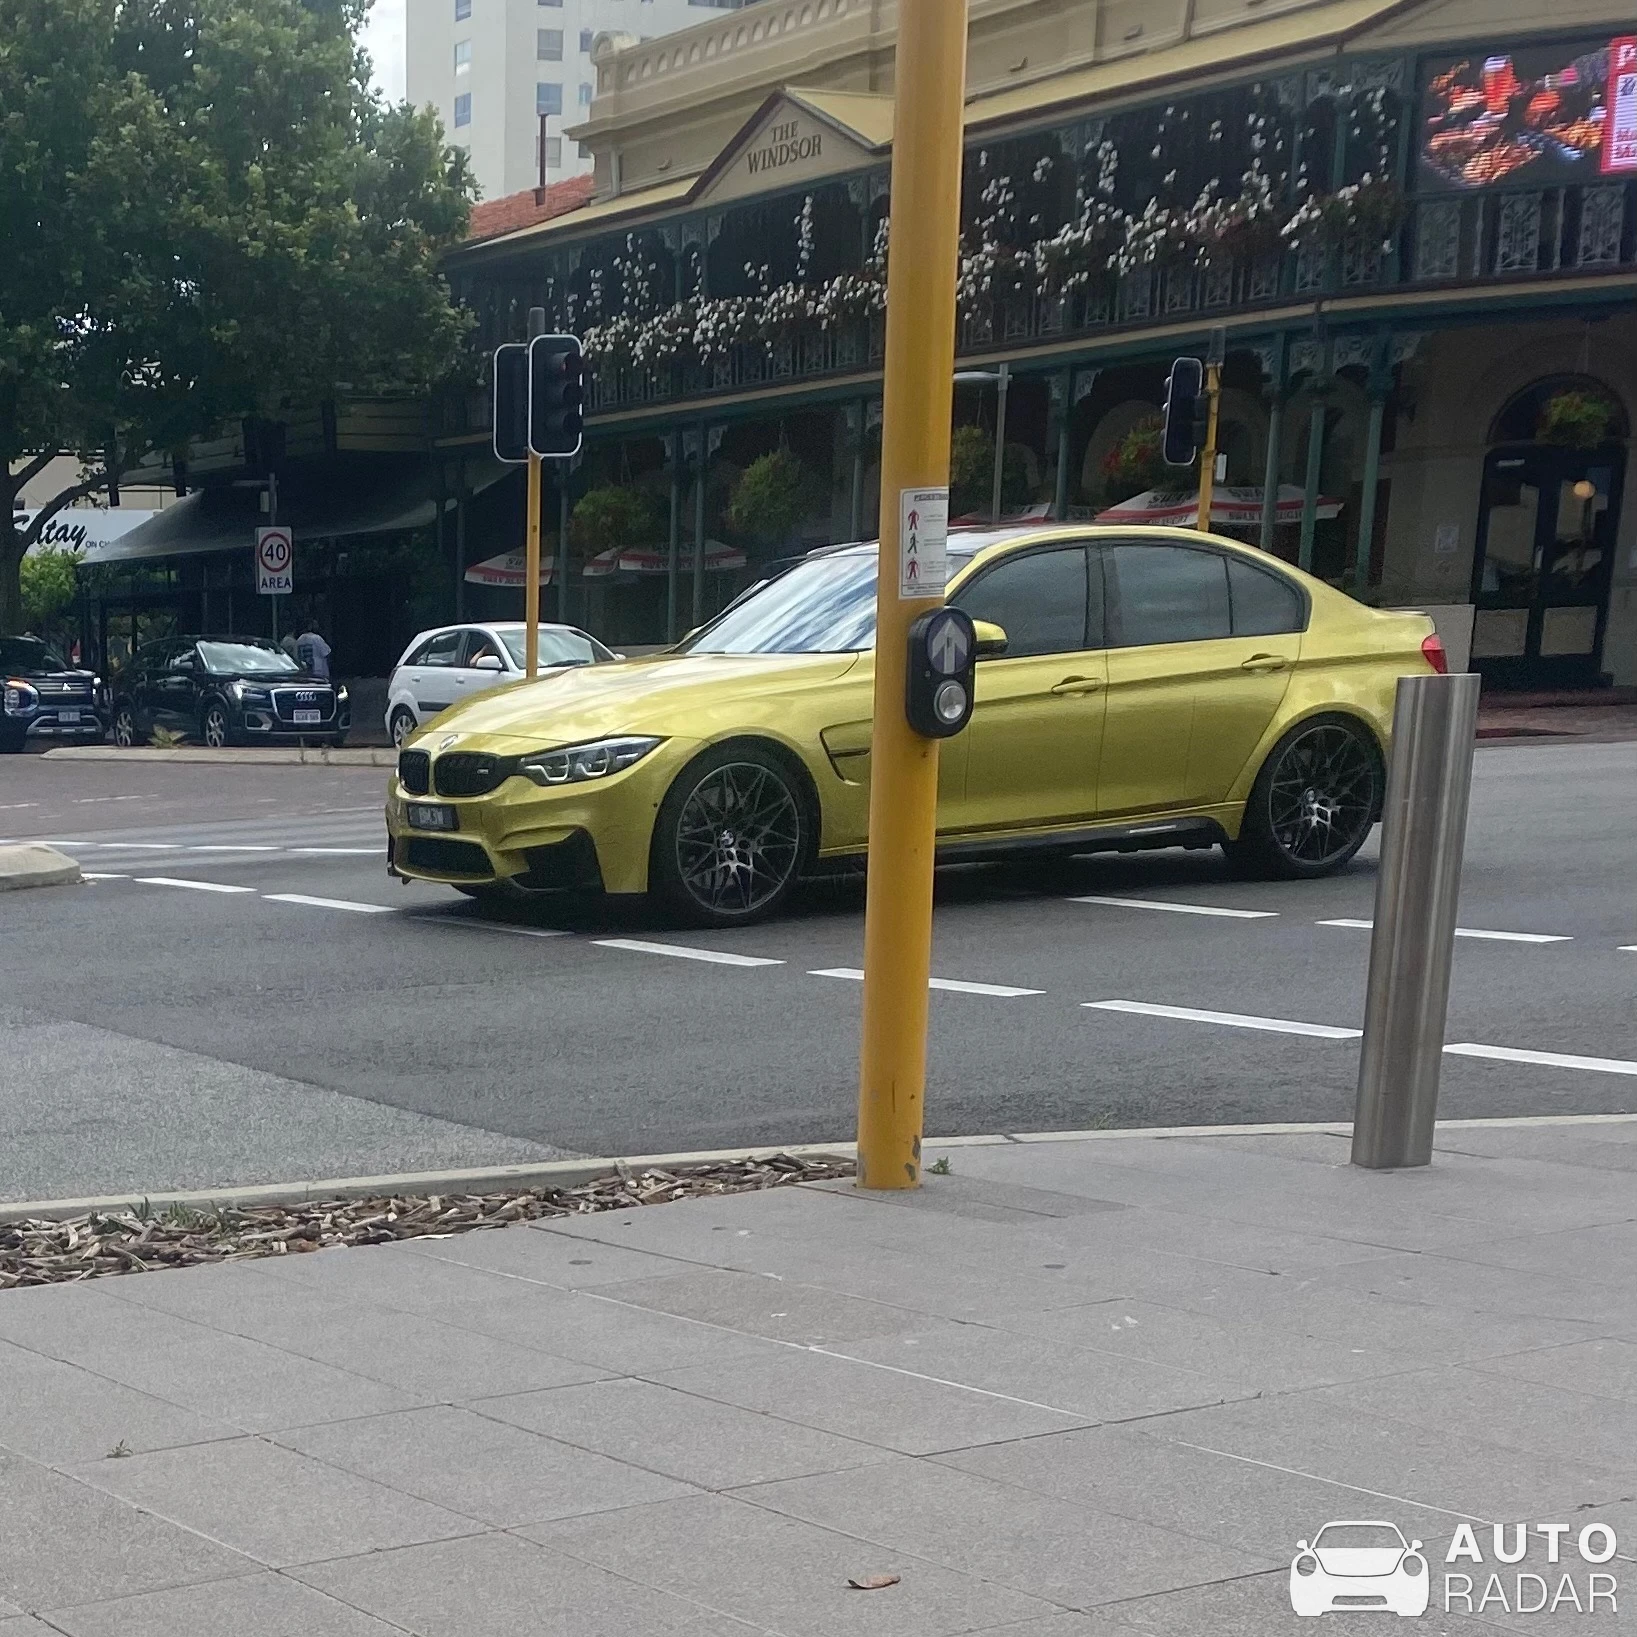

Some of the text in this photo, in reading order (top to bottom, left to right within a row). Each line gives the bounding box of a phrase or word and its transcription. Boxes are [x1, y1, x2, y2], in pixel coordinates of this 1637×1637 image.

[770, 120, 799, 142] THE
[747, 133, 822, 174] WINDSOR
[85, 540, 97, 548] ON
[264, 543, 286, 561] 40
[261, 576, 291, 589] AREA
